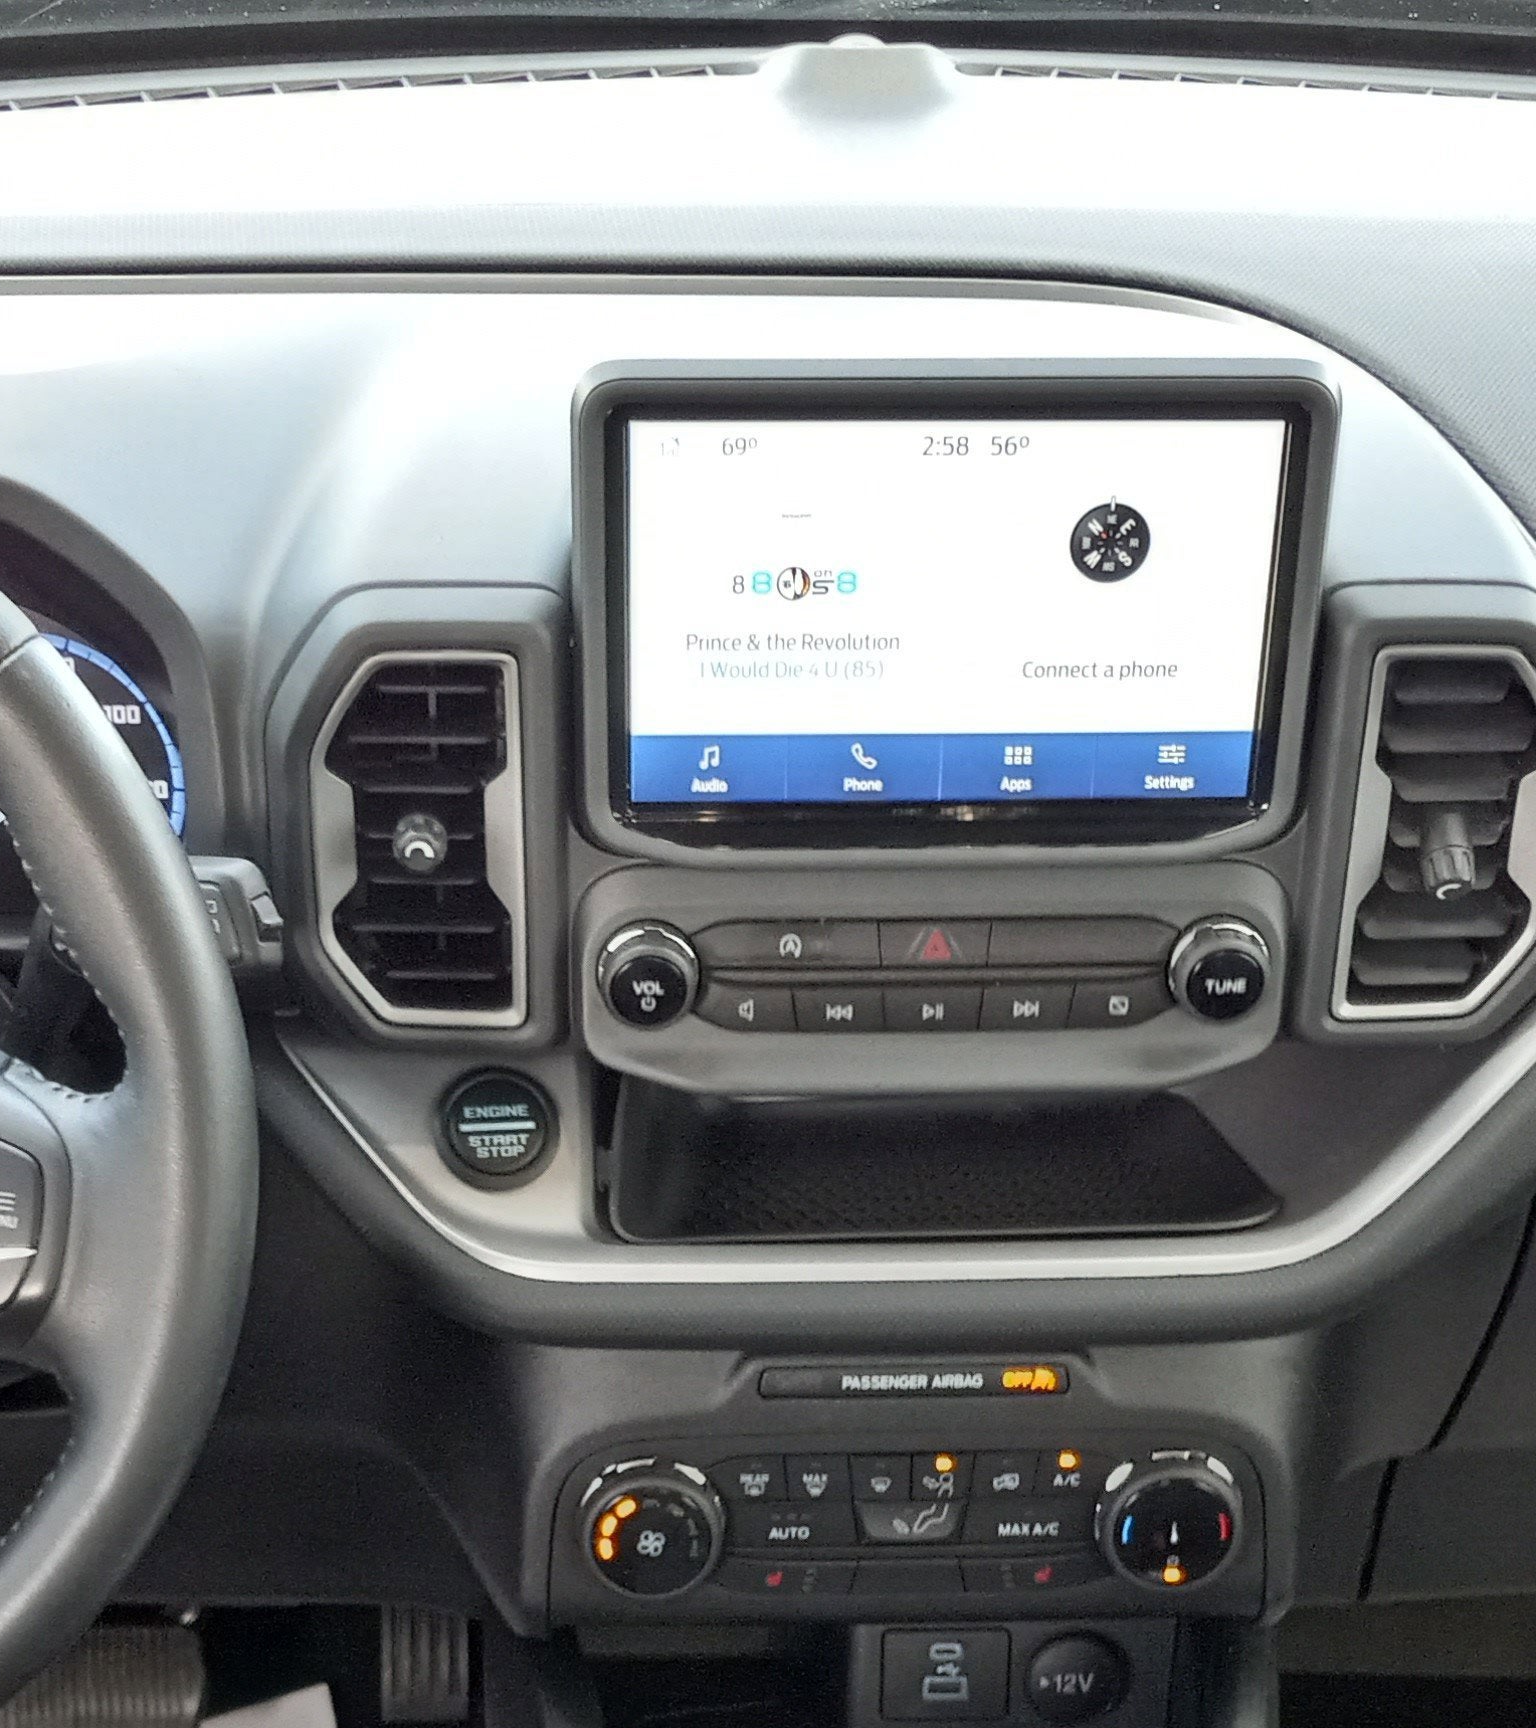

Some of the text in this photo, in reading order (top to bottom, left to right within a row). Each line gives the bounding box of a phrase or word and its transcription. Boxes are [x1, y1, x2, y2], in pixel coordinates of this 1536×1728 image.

[922, 435, 970, 457] 2:58
[686, 633, 900, 651] Prince & the Revolution
[711, 661, 769, 679] Would
[775, 661, 803, 678] Die
[825, 660, 838, 678] U
[844, 659, 884, 681] (85)
[1022, 658, 1178, 685] Connect a phone
[691, 776, 729, 793] Audio
[843, 776, 883, 793] Phone
[1000, 776, 1032, 795] Apps
[1144, 774, 1195, 794] Settings
[632, 980, 665, 997] VOL
[1204, 977, 1247, 996] TUNE
[463, 1104, 530, 1119] ENGINE
[467, 1134, 530, 1148] START
[476, 1146, 526, 1159] STOP
[841, 1374, 928, 1391] PASSENGER
[931, 1373, 984, 1390] AIRBAG
[1053, 1473, 1081, 1488] A/C
[768, 1526, 810, 1541] AUTO
[997, 1521, 1059, 1537] MAX A/C
[1052, 1672, 1094, 1695] 12V
